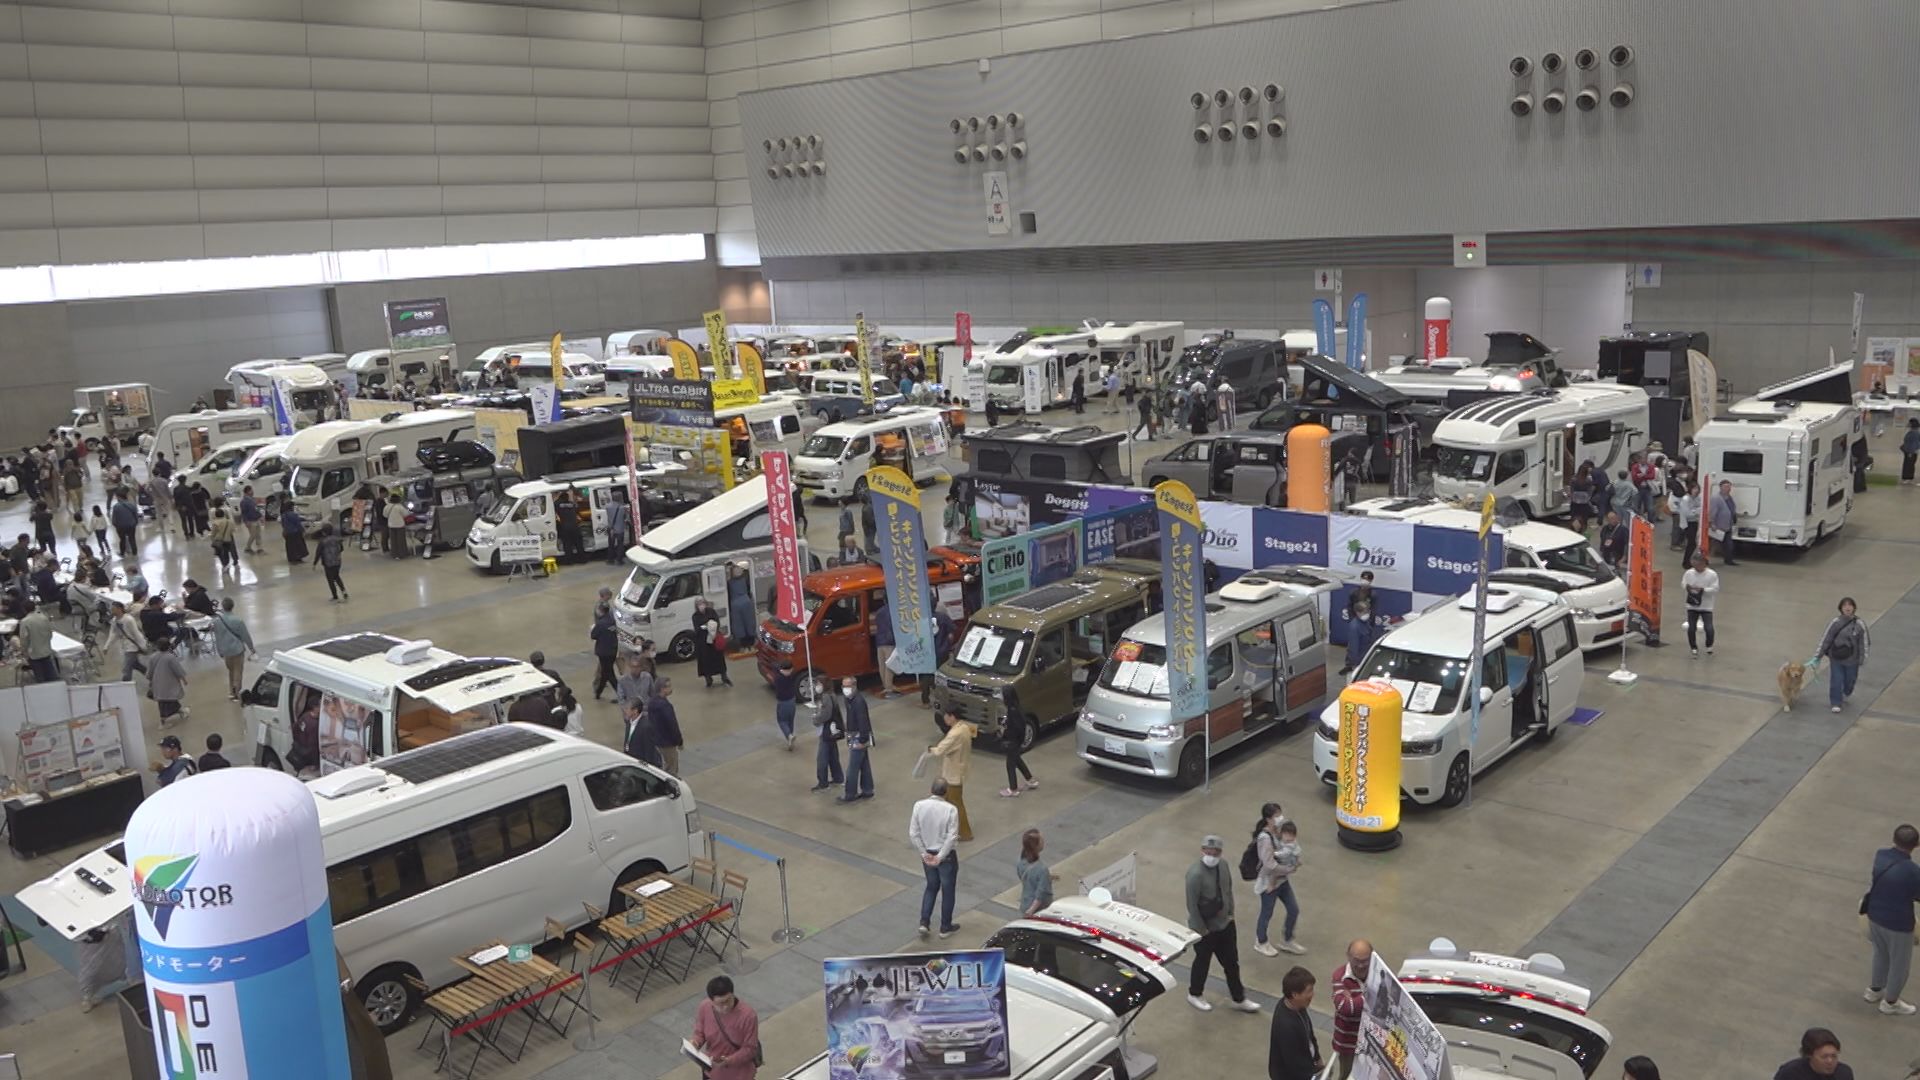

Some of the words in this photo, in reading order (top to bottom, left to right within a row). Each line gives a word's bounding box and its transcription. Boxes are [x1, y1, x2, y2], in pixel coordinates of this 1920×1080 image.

[990, 180, 1004, 199] A
[634, 383, 670, 394] ULTRA
[672, 386, 708, 397] CABIN
[1044, 493, 1090, 510] Doggy
[1087, 525, 1115, 549] EASE
[1201, 529, 1238, 548] Duo
[1265, 537, 1318, 553] Stage21
[987, 551, 1025, 574] CURIO
[1352, 549, 1396, 567] Duo
[1427, 556, 1479, 574] Stage2
[143, 951, 247, 973] ンドモーター
[892, 960, 993, 996] JEWEL
